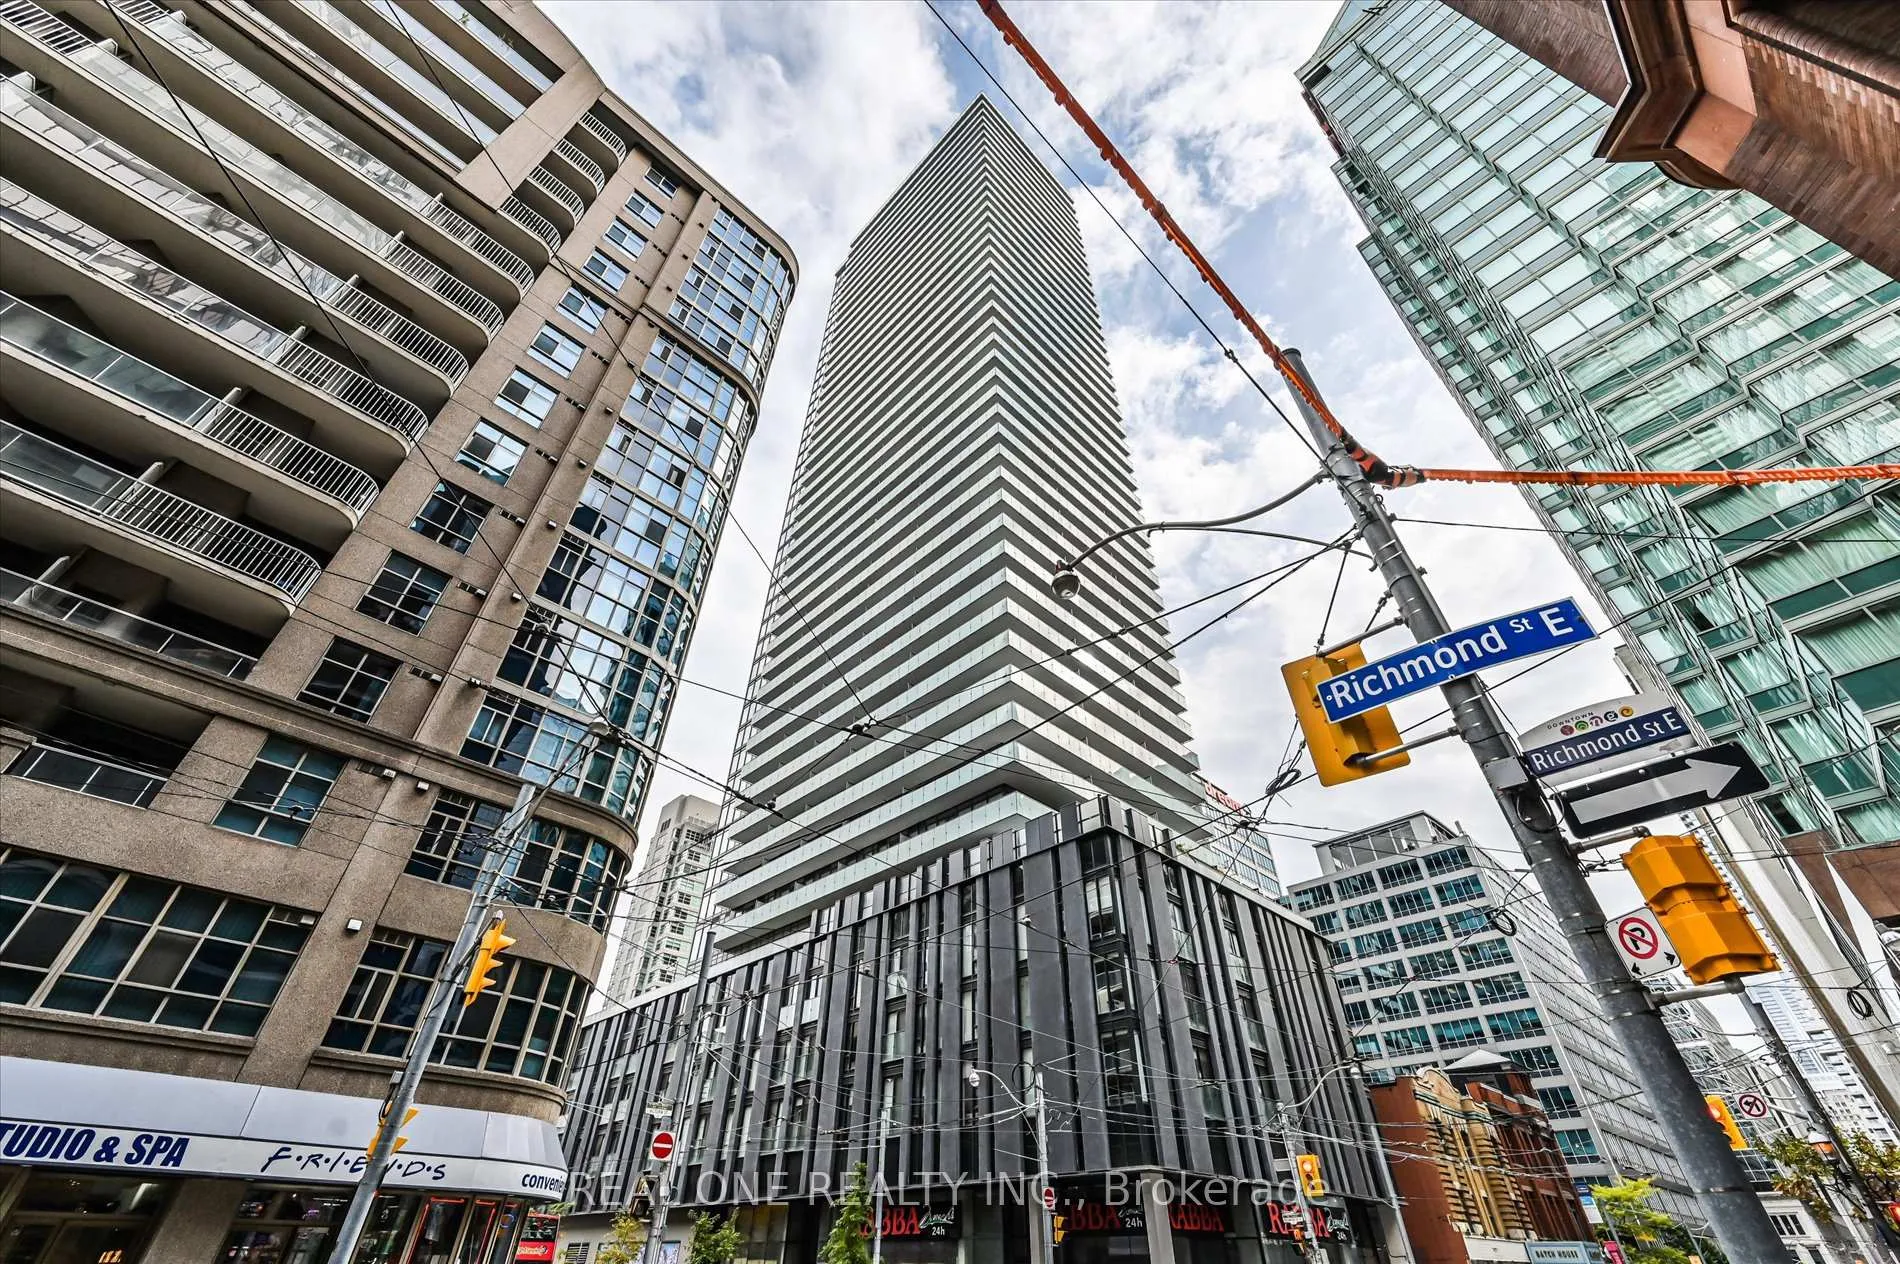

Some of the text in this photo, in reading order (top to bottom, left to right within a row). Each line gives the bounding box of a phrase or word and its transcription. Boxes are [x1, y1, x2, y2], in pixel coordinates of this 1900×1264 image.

[1330, 607, 1574, 709] Richmond St E
[1547, 711, 1595, 730] DOWNTOWN
[1531, 711, 1682, 772] Richmond St E
[93, 1136, 121, 1163] &
[124, 1133, 190, 1167] SPA
[931, 1225, 946, 1236] 24h
[1125, 1217, 1143, 1228] 24h
